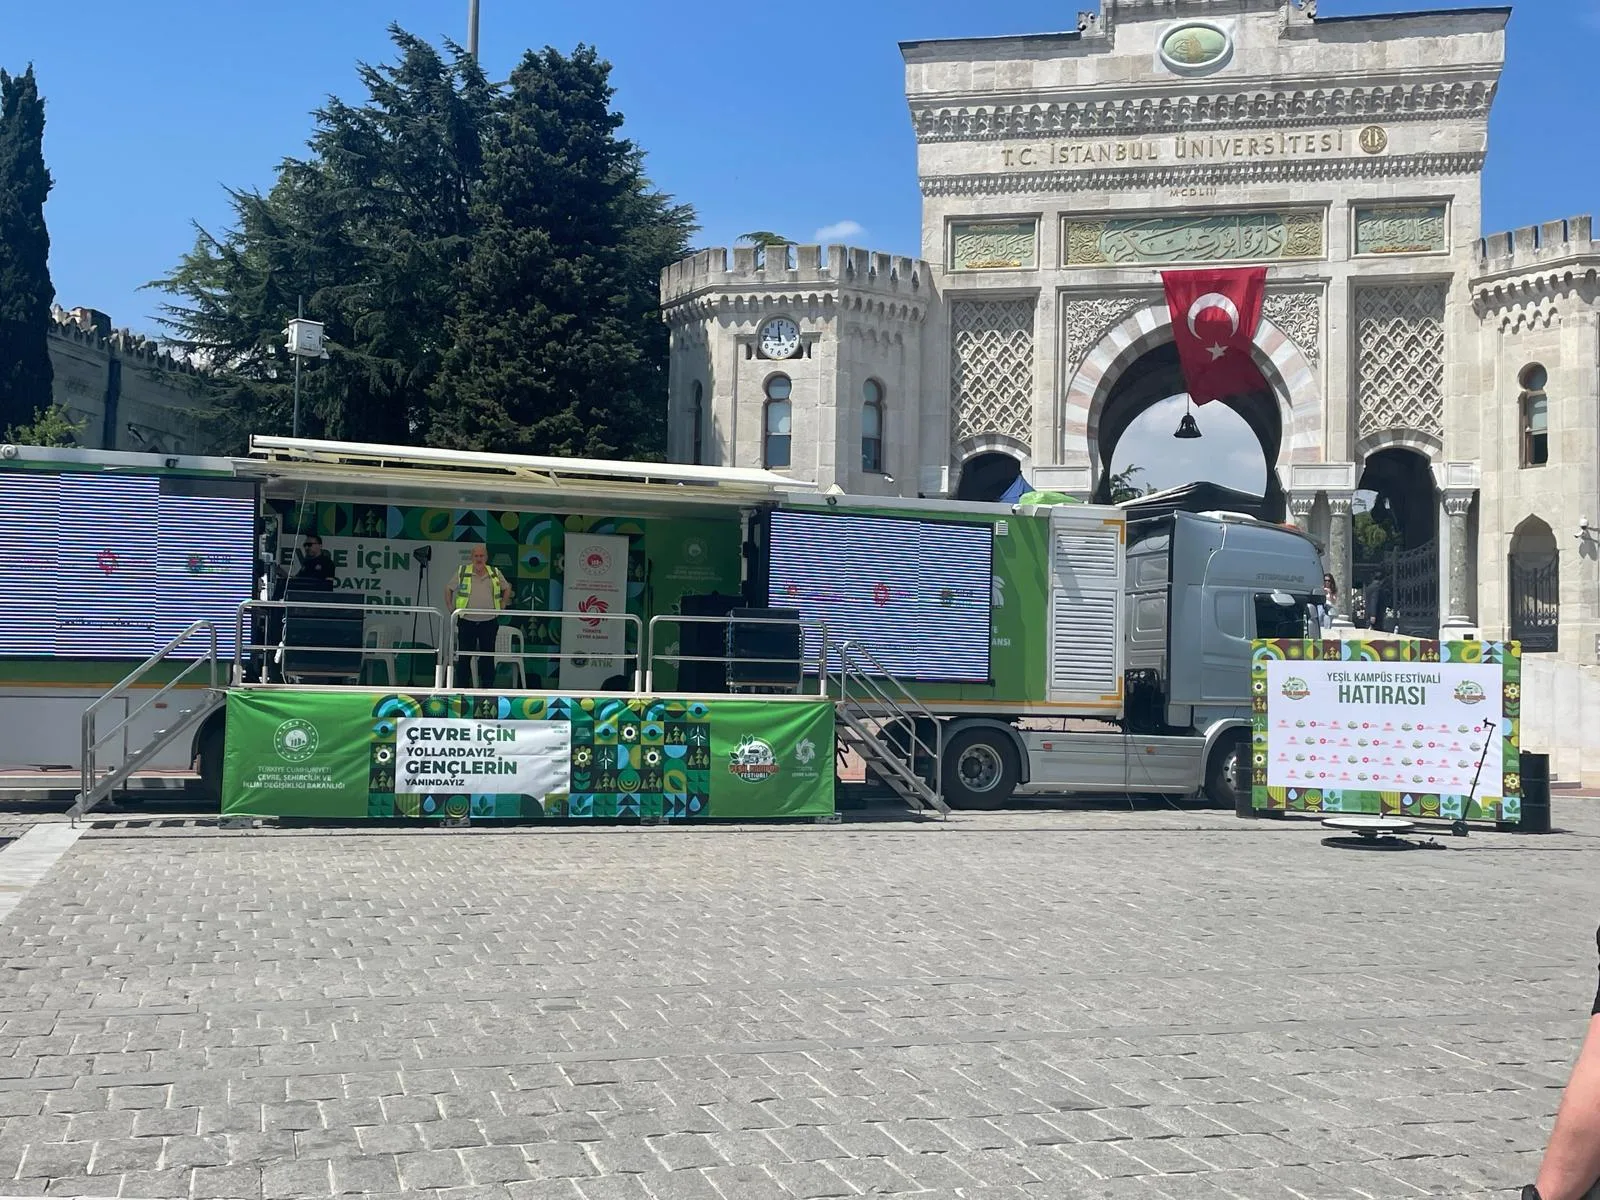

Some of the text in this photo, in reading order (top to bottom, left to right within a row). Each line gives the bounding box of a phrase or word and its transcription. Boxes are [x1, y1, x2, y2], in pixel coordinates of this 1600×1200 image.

[1001, 128, 1343, 166] T.C. İSTANBUL ÜNİVERSİTESİ
[1169, 187, 1217, 197] MCDLIII
[357, 544, 410, 574] İÇİN
[1327, 671, 1441, 684] YEŞİL KAMPÜS FESTİVALİ
[1338, 685, 1425, 705] HATIRASI
[406, 724, 516, 745] ÇEVRE İÇİN
[406, 747, 495, 758] YOLLARDAYIZ
[405, 757, 517, 778] GENÇLERİN
[405, 778, 464, 786] YANINDAYIZ
